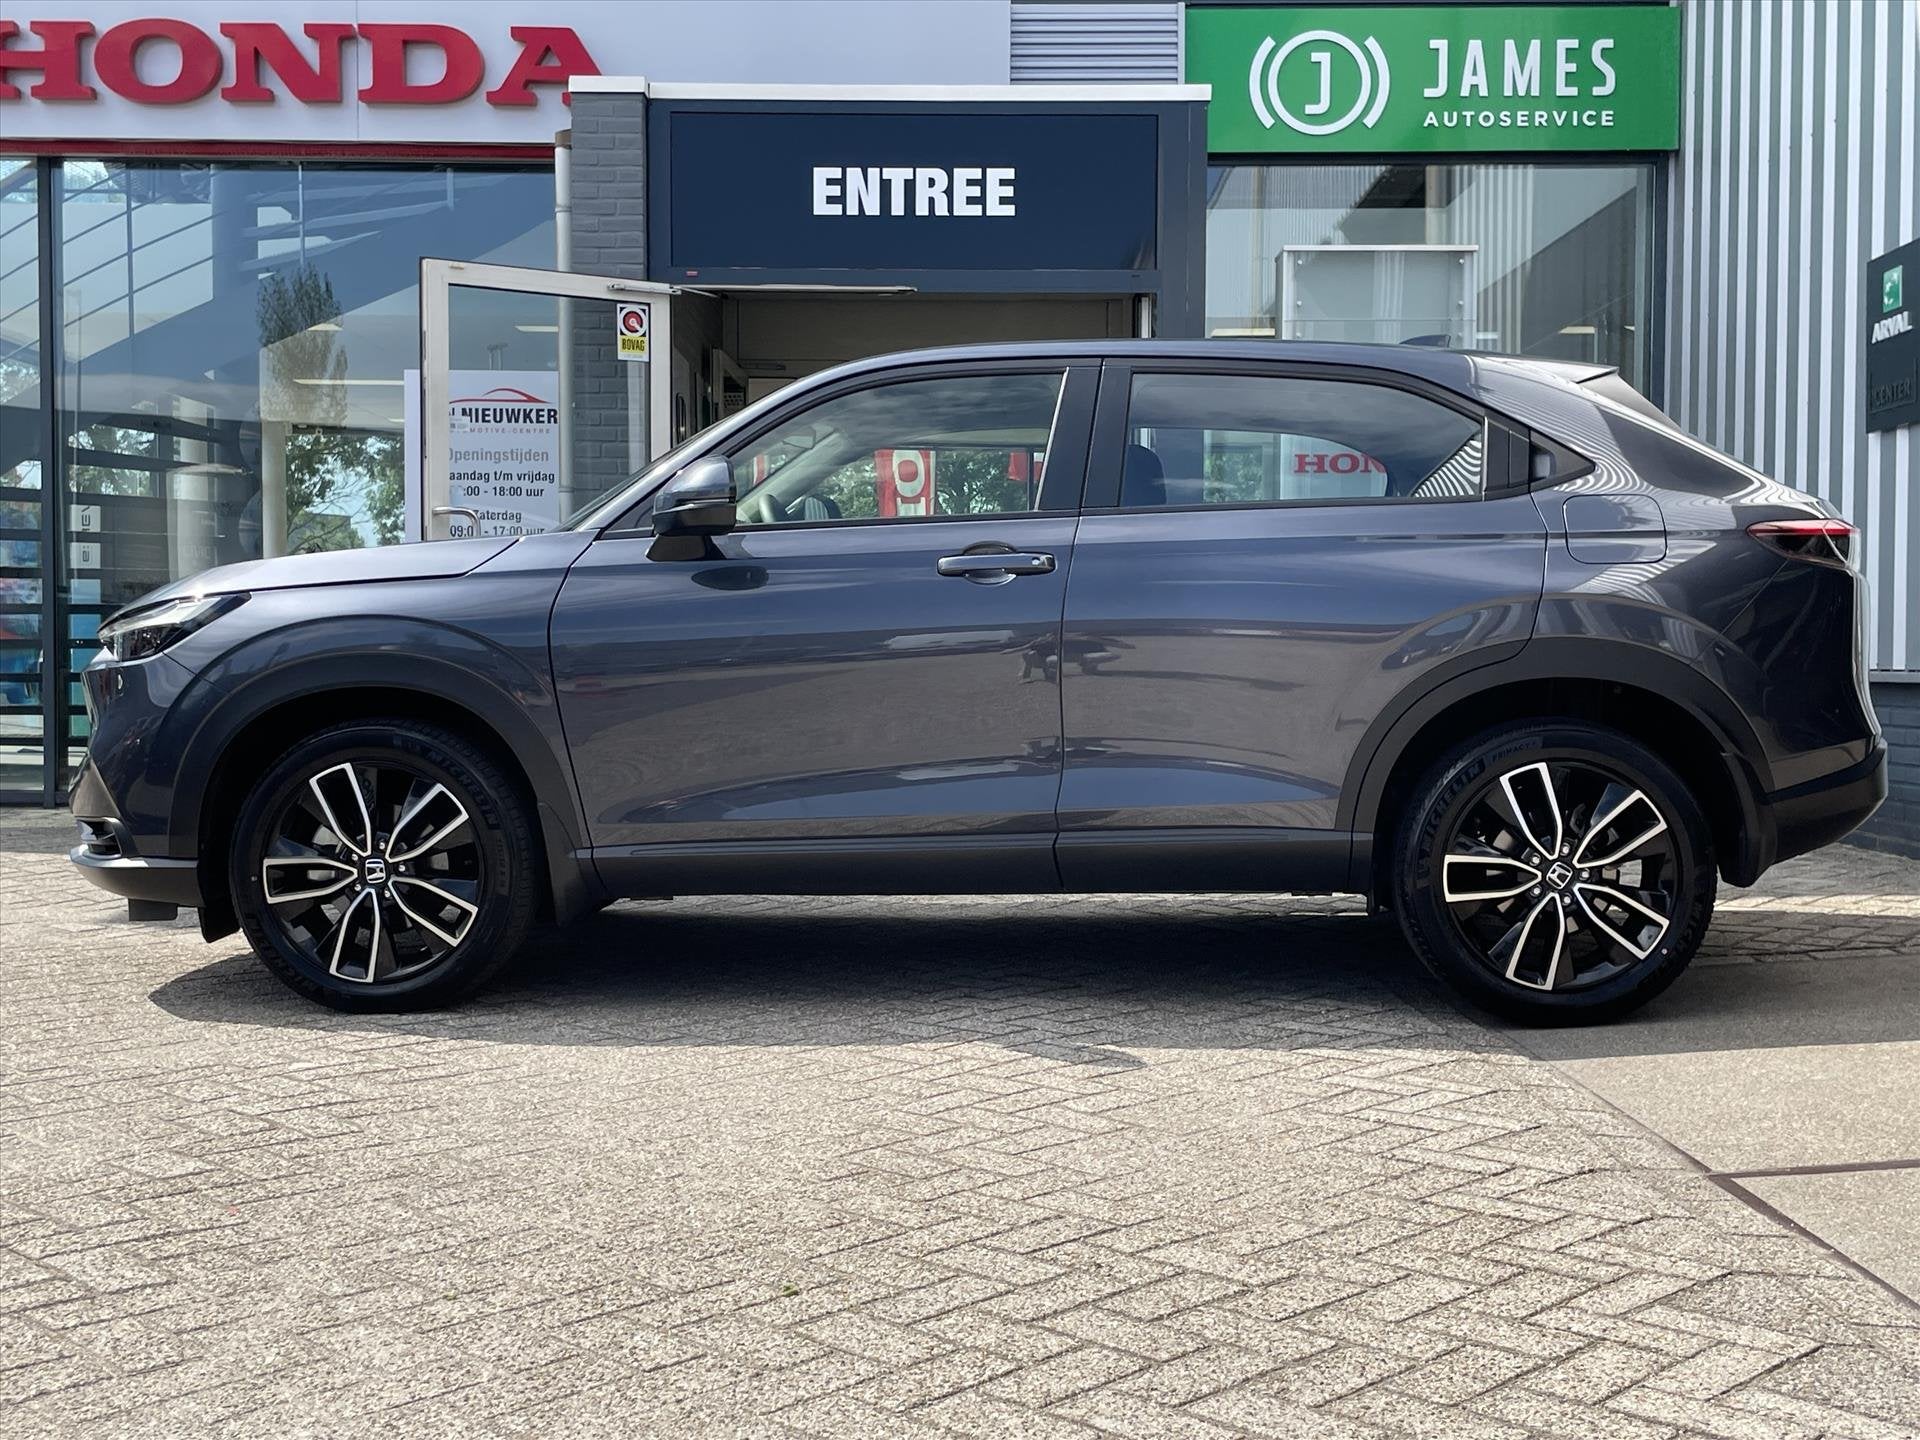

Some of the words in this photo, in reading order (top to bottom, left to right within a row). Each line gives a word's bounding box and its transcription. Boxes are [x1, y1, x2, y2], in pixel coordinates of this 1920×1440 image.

[0, 18, 601, 106] HONDA
[1423, 39, 1616, 98] JAMES
[1423, 110, 1614, 128] AUTOSERVICE
[812, 166, 1017, 217] ENTREE
[1871, 310, 1912, 343] ARVAL
[621, 338, 646, 352] BOVAG
[449, 470, 490, 483] aandag
[493, 470, 513, 481] t/m
[516, 471, 555, 483] vrijdag
[492, 486, 522, 497] 18:00
[526, 488, 545, 497] uur
[449, 525, 474, 537] 09:0
[492, 525, 523, 537] 17:00
